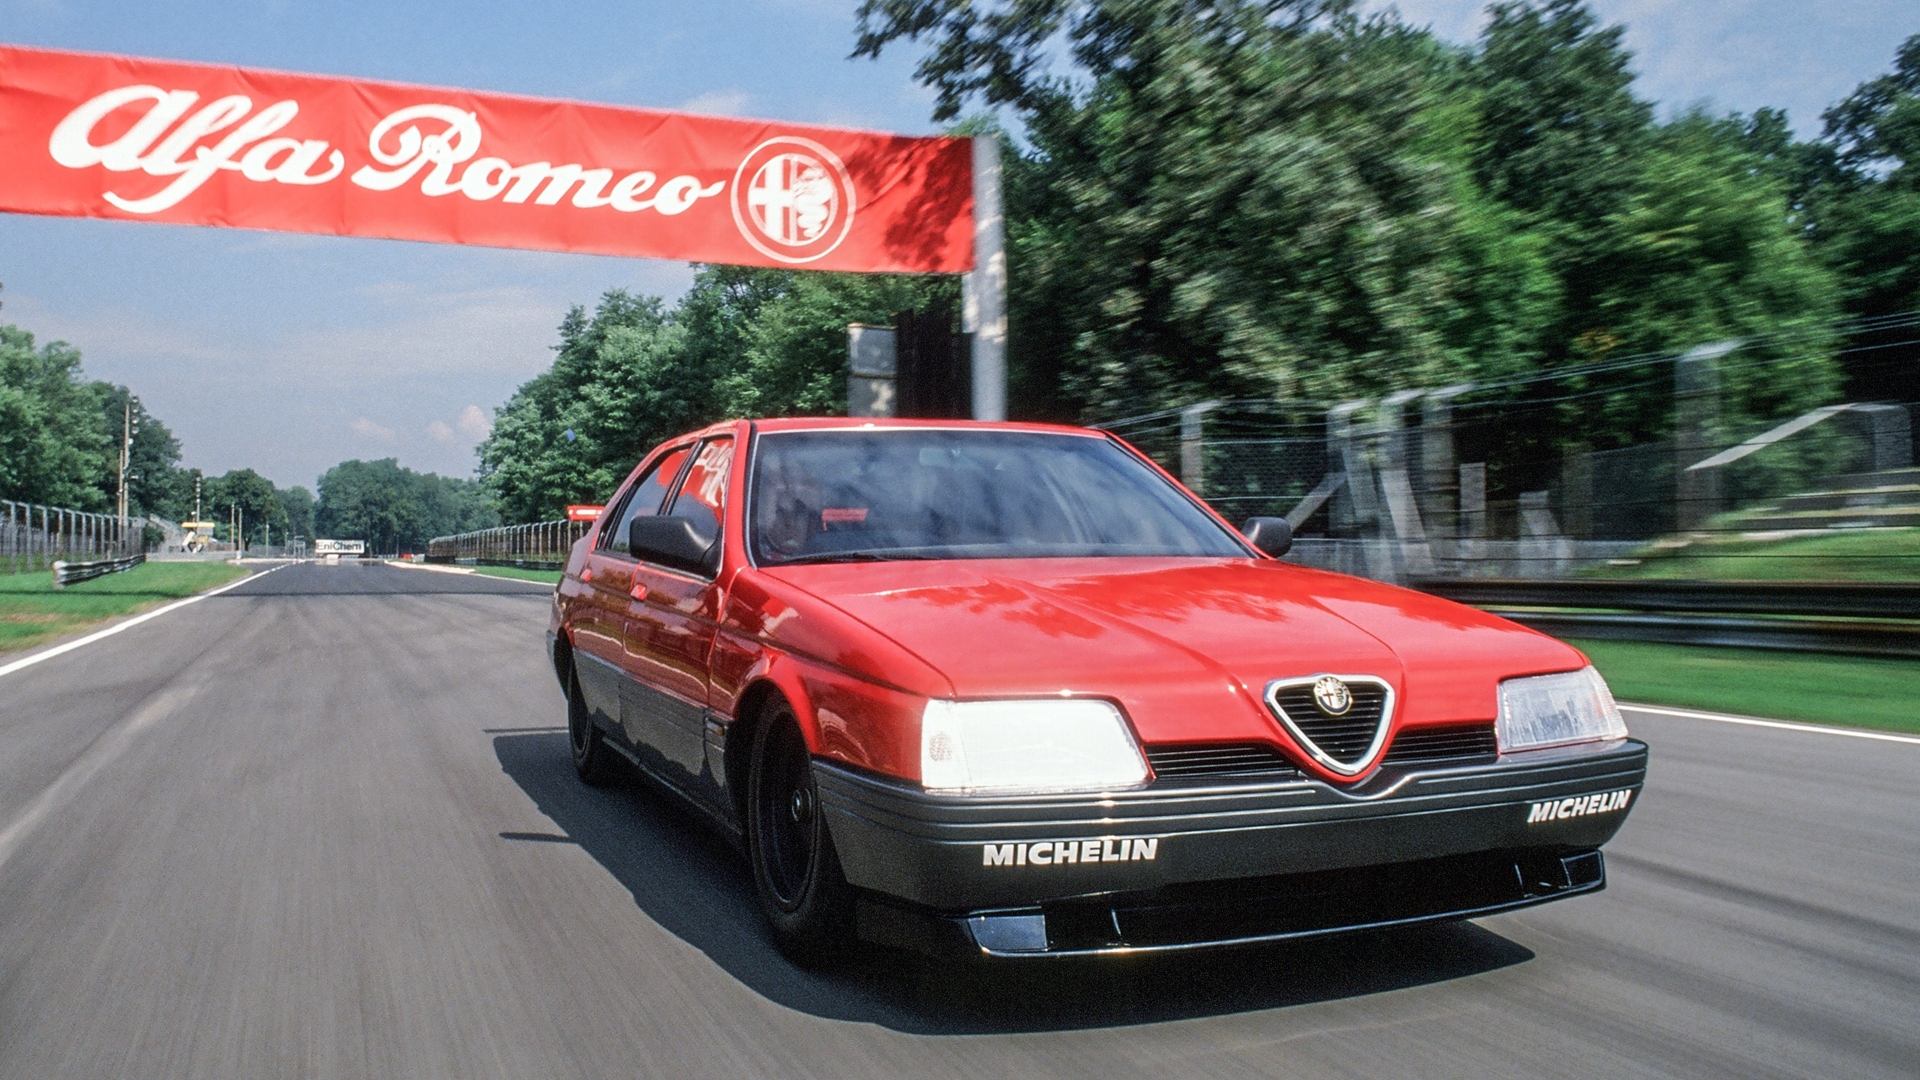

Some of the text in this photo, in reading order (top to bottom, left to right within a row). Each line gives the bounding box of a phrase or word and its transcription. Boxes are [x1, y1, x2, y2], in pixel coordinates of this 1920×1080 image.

[48, 84, 726, 215] Alfa Romeo
[1527, 789, 1632, 823] MICHELIN
[982, 838, 1158, 866] MICHELIN
